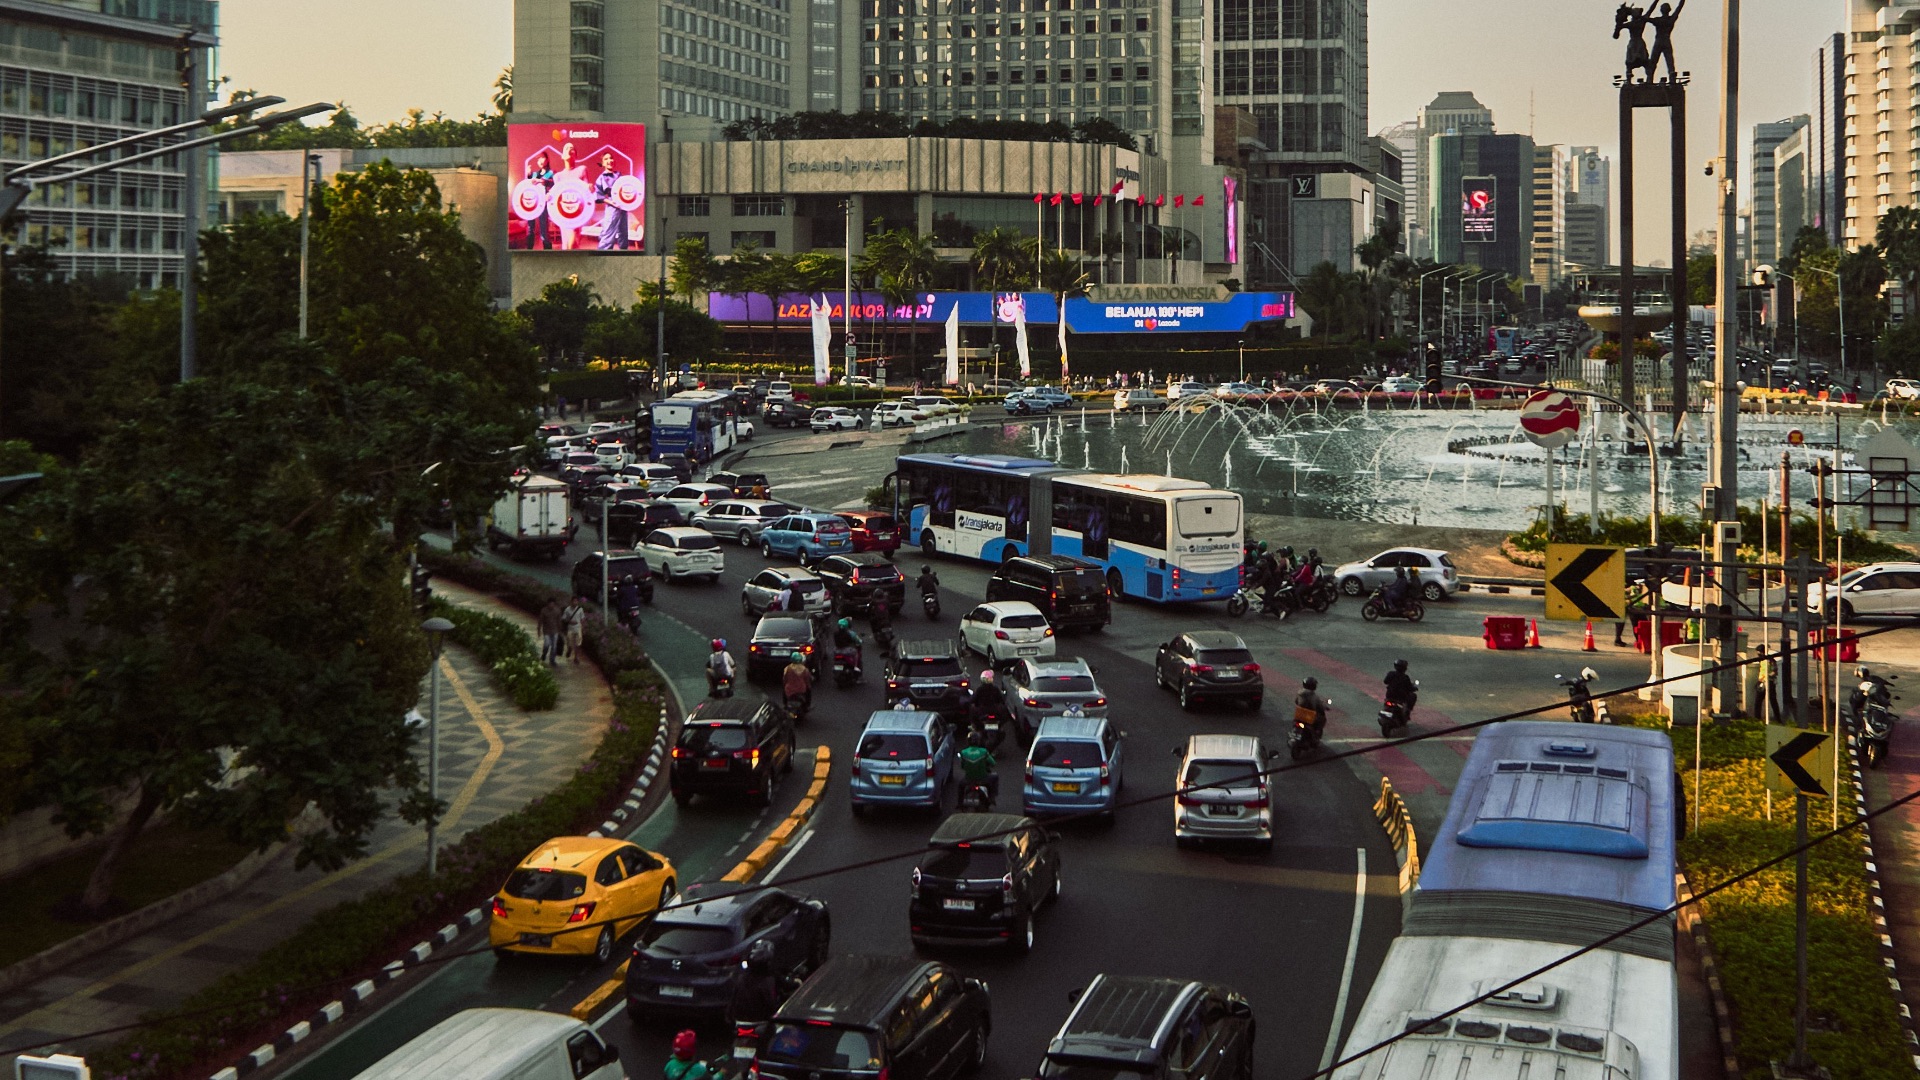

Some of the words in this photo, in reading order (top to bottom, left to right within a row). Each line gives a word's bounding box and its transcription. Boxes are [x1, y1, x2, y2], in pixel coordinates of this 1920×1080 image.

[787, 160, 842, 172] GRAND
[851, 159, 904, 172] HYATT
[1098, 286, 1142, 301] PLAZA
[1146, 285, 1218, 300] INDONESIA
[778, 303, 844, 319] LAZA
[1105, 306, 1157, 318] BELANJA
[1177, 306, 1204, 317] HEPI
[1134, 319, 1144, 328] DI
[964, 515, 1003, 532] transjakarta
